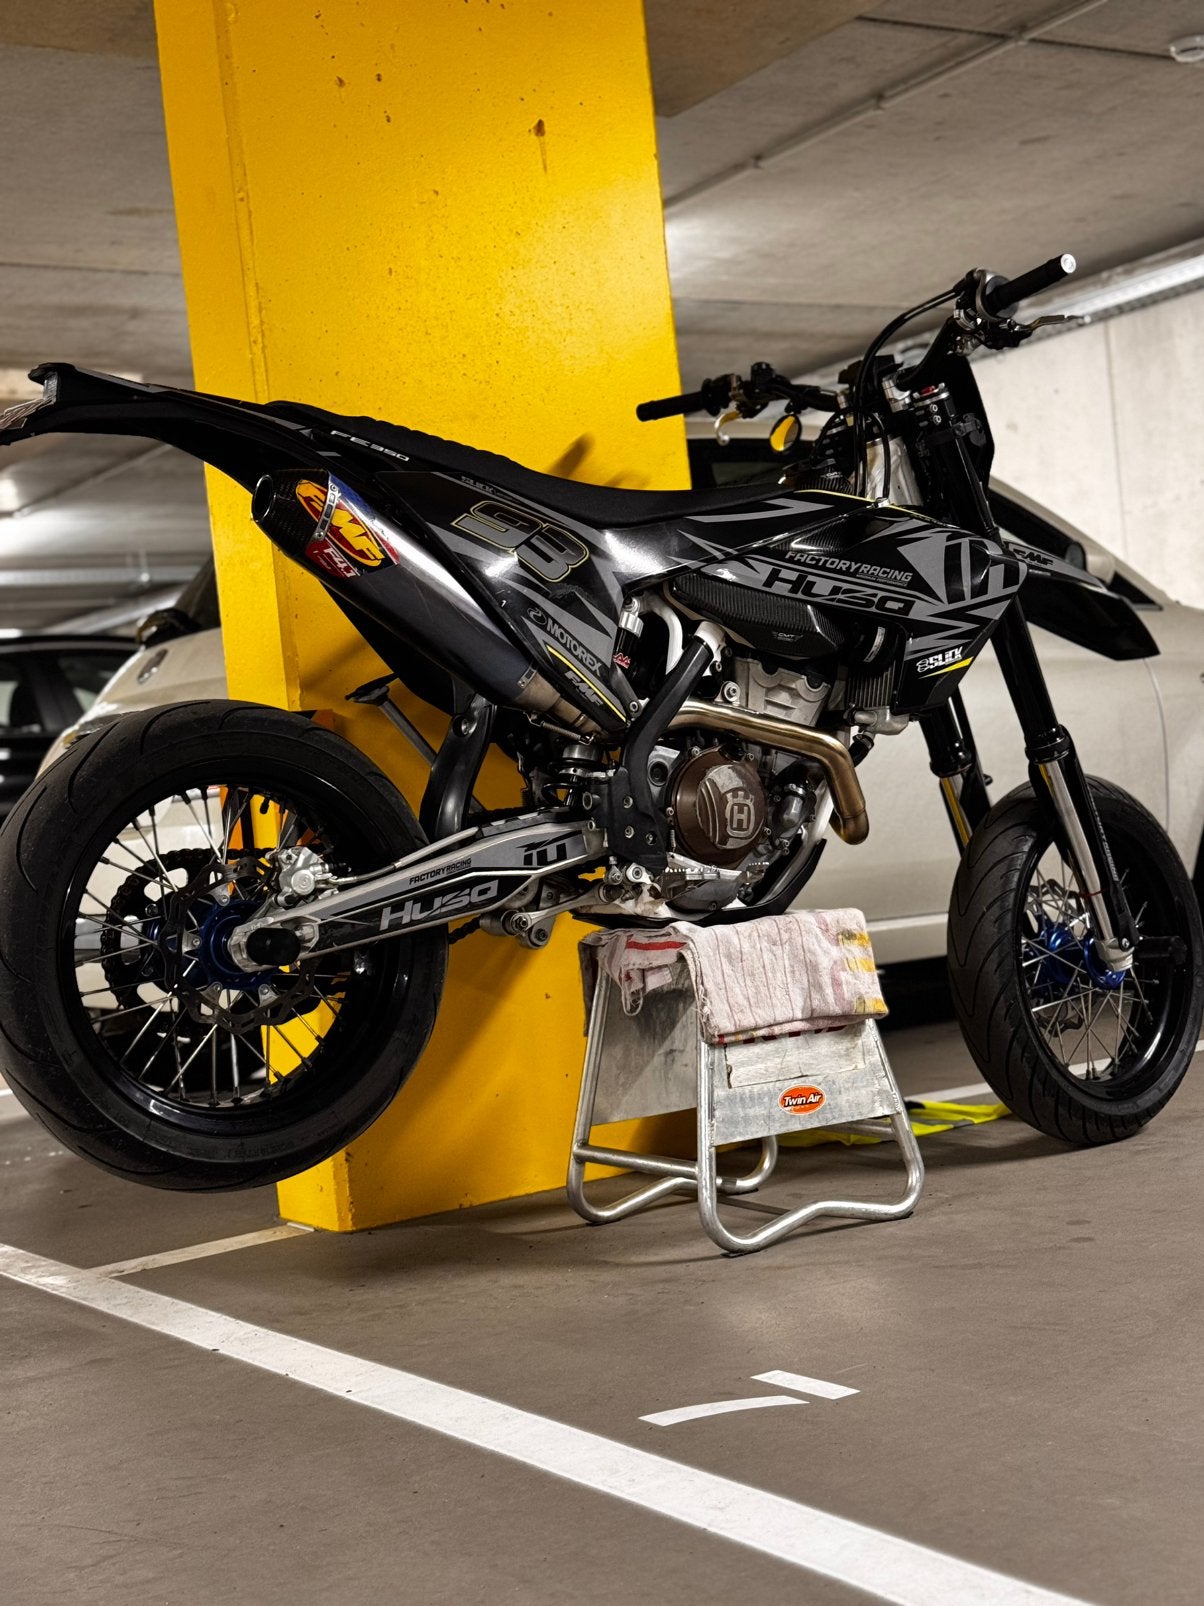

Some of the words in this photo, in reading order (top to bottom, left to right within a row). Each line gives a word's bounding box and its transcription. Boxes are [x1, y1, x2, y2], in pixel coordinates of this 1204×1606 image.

[785, 551, 860, 573] FACTORY
[859, 564, 913, 582] RACING
[546, 618, 603, 677] MOTOREX
[409, 868, 447, 885] FACTORY
[783, 1094, 807, 1107] Twin
[806, 1092, 823, 1104] Air
